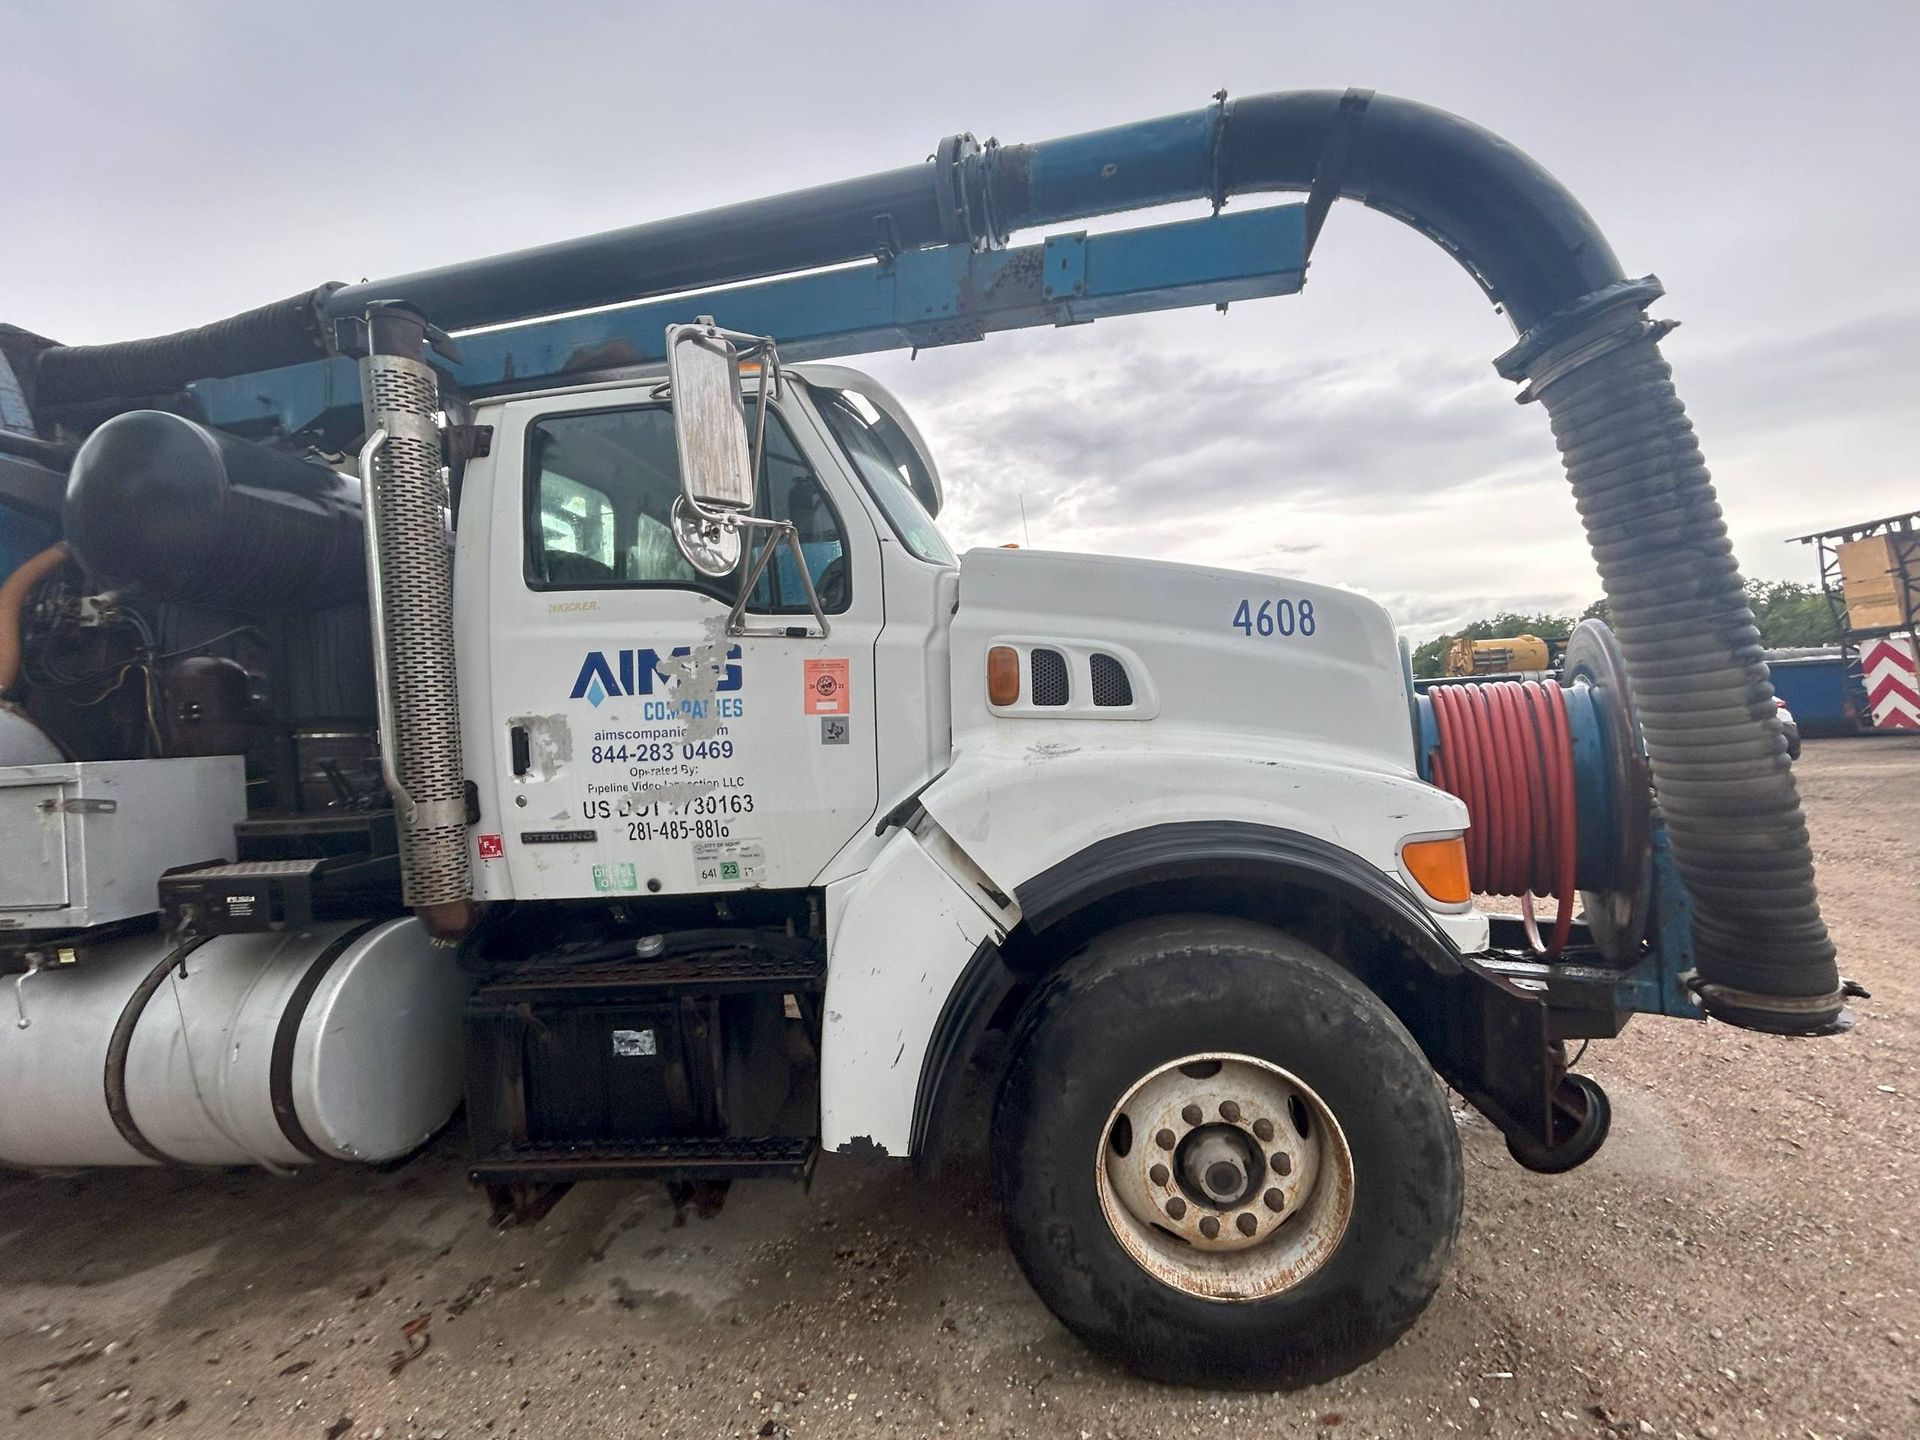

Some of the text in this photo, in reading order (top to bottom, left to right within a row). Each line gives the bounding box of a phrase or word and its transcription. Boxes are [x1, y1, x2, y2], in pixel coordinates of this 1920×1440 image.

[1232, 598, 1316, 637] 4608
[591, 740, 734, 764] 844-2830469
[587, 782, 629, 795] Pipeline
[723, 776, 745, 788] LLC
[583, 800, 611, 819] US
[669, 794, 754, 816] 730163
[524, 830, 594, 842] STERLING
[722, 864, 737, 875] 23
